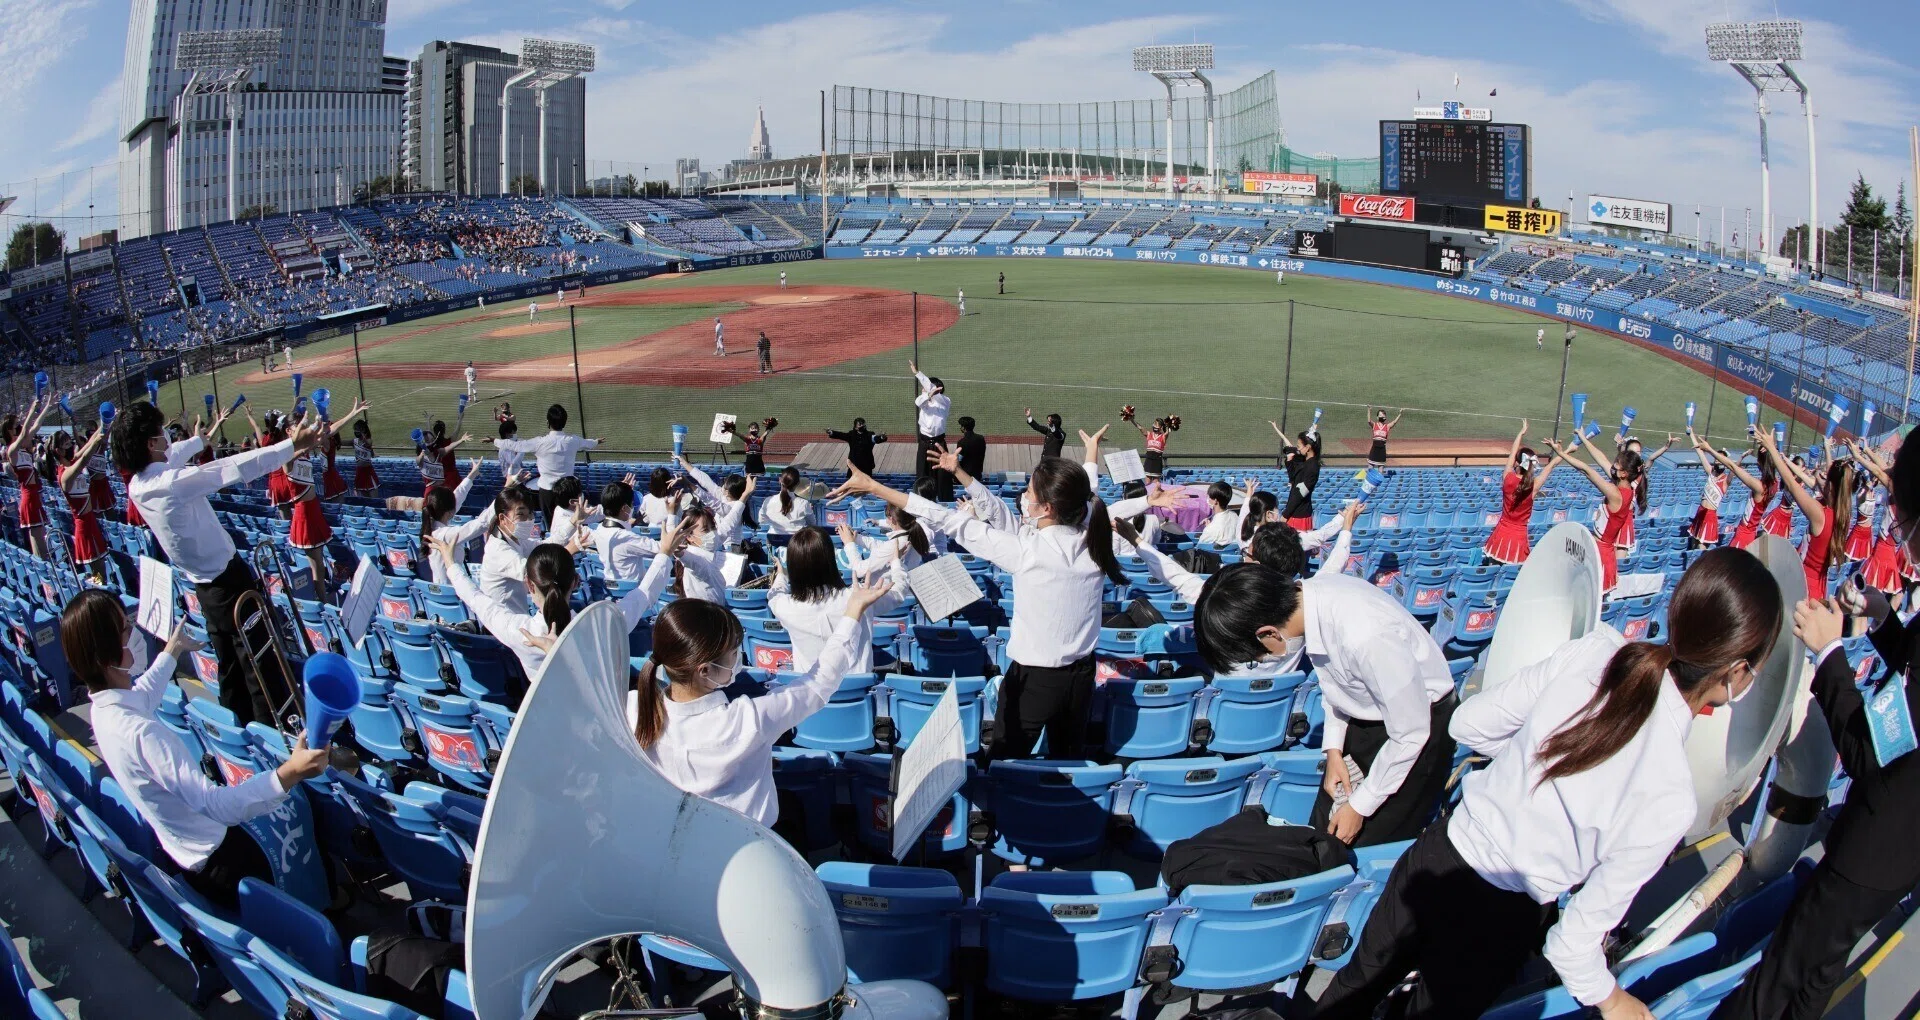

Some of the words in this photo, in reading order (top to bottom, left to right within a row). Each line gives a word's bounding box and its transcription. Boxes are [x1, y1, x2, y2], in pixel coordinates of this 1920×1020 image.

[1386, 137, 1398, 188] マイナビ
[1507, 142, 1520, 198] マイナビ
[1264, 182, 1315, 194] フージャース
[1489, 210, 1556, 234] 一番搾り
[1609, 204, 1666, 226] 住友重機械
[772, 250, 814, 262] ONWARD
[863, 248, 908, 257] エナセーブ
[1011, 246, 1047, 256] 文教大学
[1063, 247, 1114, 258] 東進ハイスクール
[1136, 250, 1177, 261] 安藤ハザマ
[1210, 253, 1248, 267] 東鉄工業
[1270, 258, 1305, 272] 住友化学
[1499, 290, 1537, 308] 竹中工務店
[1556, 302, 1594, 323] 安藤ハザマ
[1685, 337, 1714, 362] 清水建設
